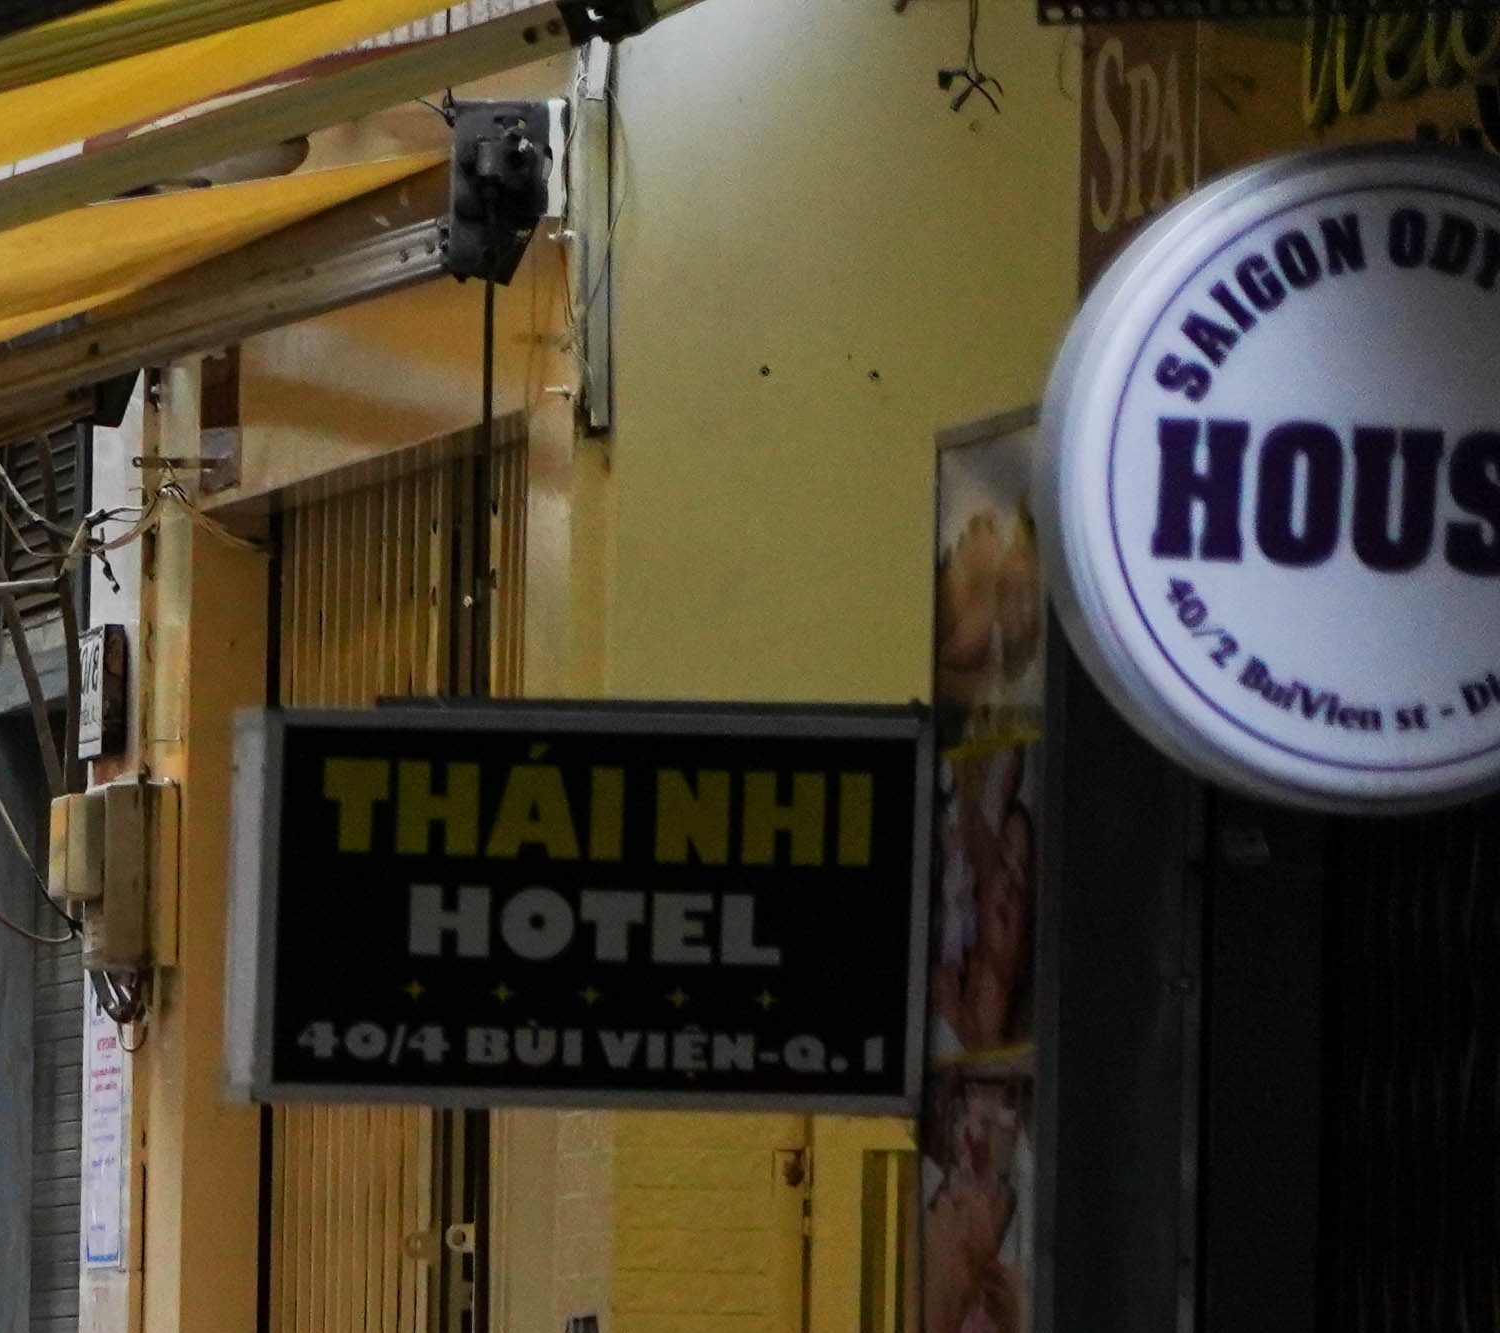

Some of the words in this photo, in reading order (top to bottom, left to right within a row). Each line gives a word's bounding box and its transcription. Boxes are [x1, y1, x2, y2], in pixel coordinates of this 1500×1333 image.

[1090, 36, 1187, 233] SPA
[1155, 211, 1368, 403] SAIGON
[322, 743, 626, 864] THÁI
[654, 768, 875, 868] NHI
[407, 882, 783, 969] HOTEL
[297, 1019, 451, 1066] 40/4
[467, 1018, 584, 1069] BÙI
